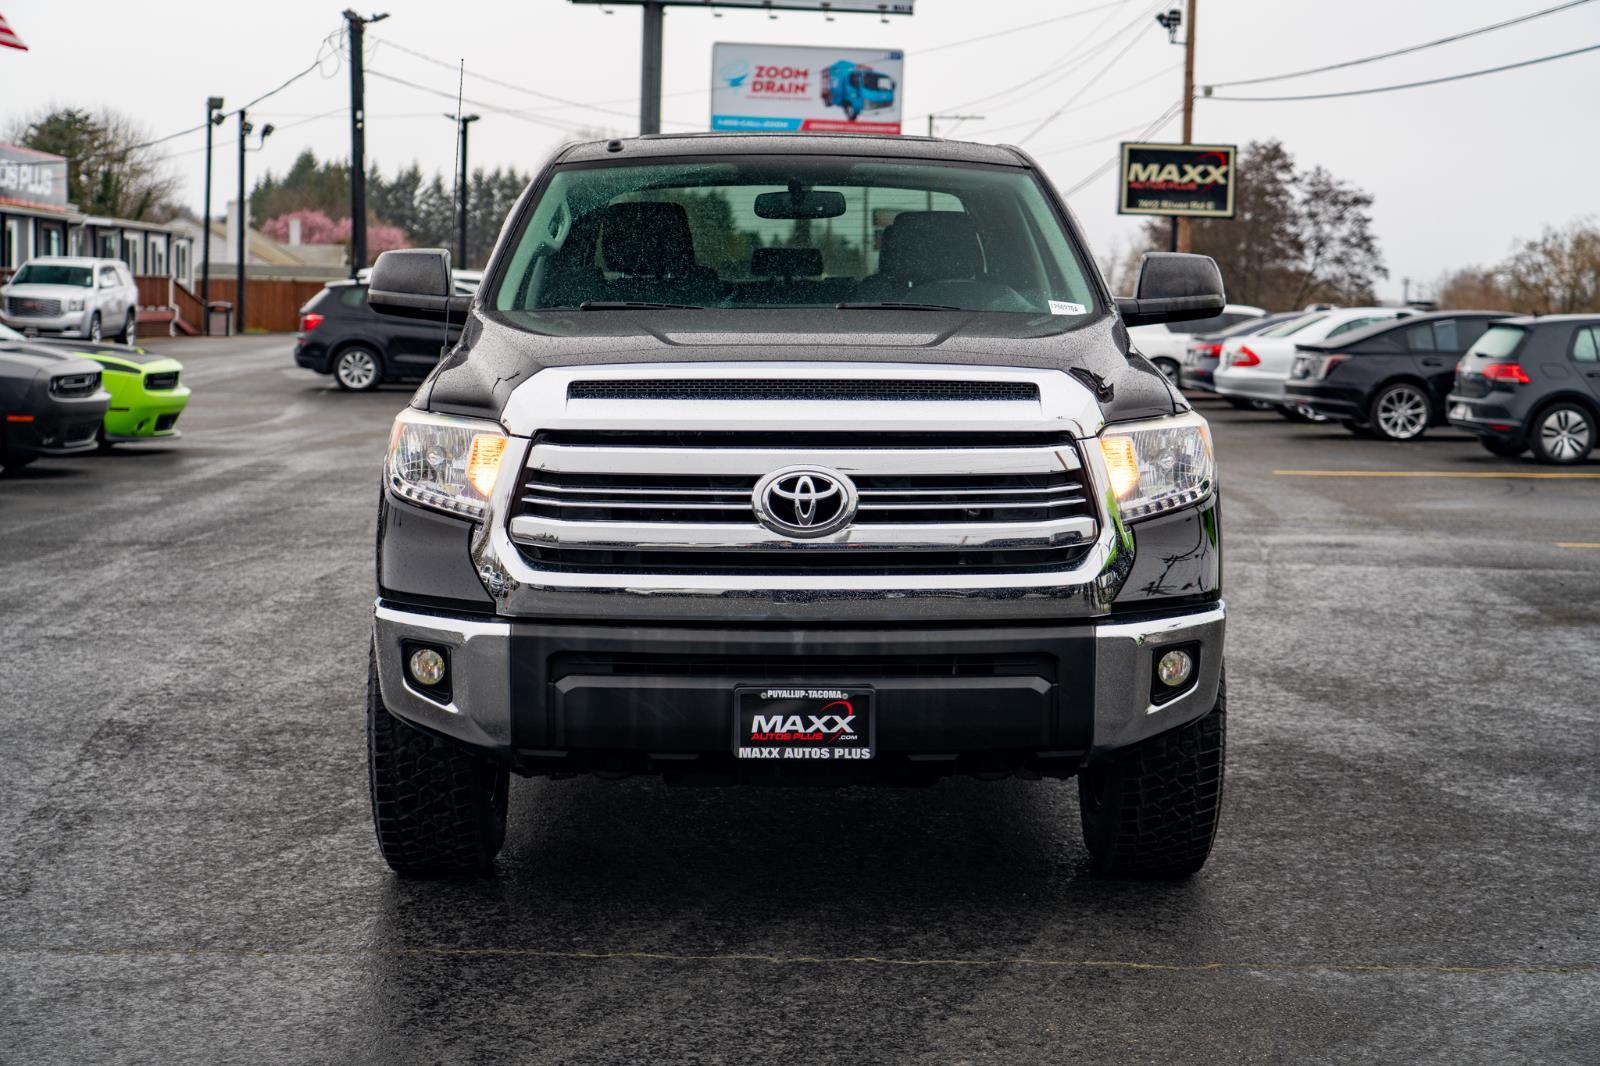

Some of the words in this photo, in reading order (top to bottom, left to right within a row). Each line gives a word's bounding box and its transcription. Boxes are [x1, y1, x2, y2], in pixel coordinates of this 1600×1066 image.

[755, 65, 808, 80] ZOOM
[752, 80, 806, 94] DRAIN
[19, 164, 53, 196] PLUS
[1128, 163, 1228, 184] MAXX
[751, 715, 856, 733] MAXX
[751, 732, 791, 740] AUTOS
[793, 732, 823, 740] PLUS
[739, 747, 780, 759] MAXX
[784, 747, 830, 759] AUTOS
[834, 748, 871, 759] PLUS
